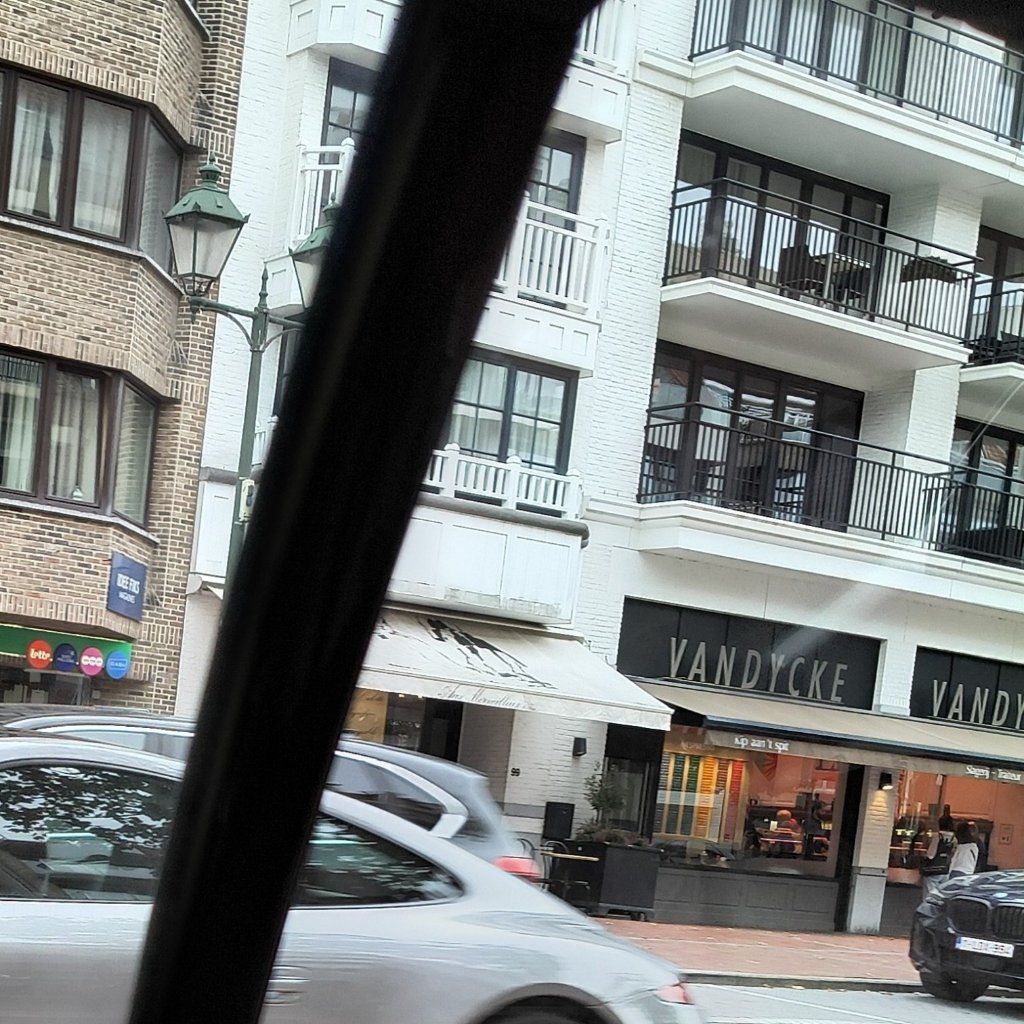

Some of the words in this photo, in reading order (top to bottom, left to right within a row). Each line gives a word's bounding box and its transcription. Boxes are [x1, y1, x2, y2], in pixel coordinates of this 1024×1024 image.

[117, 573, 129, 590] IDEE
[669, 637, 849, 704] VANDYCKE
[775, 740, 790, 753] spit
